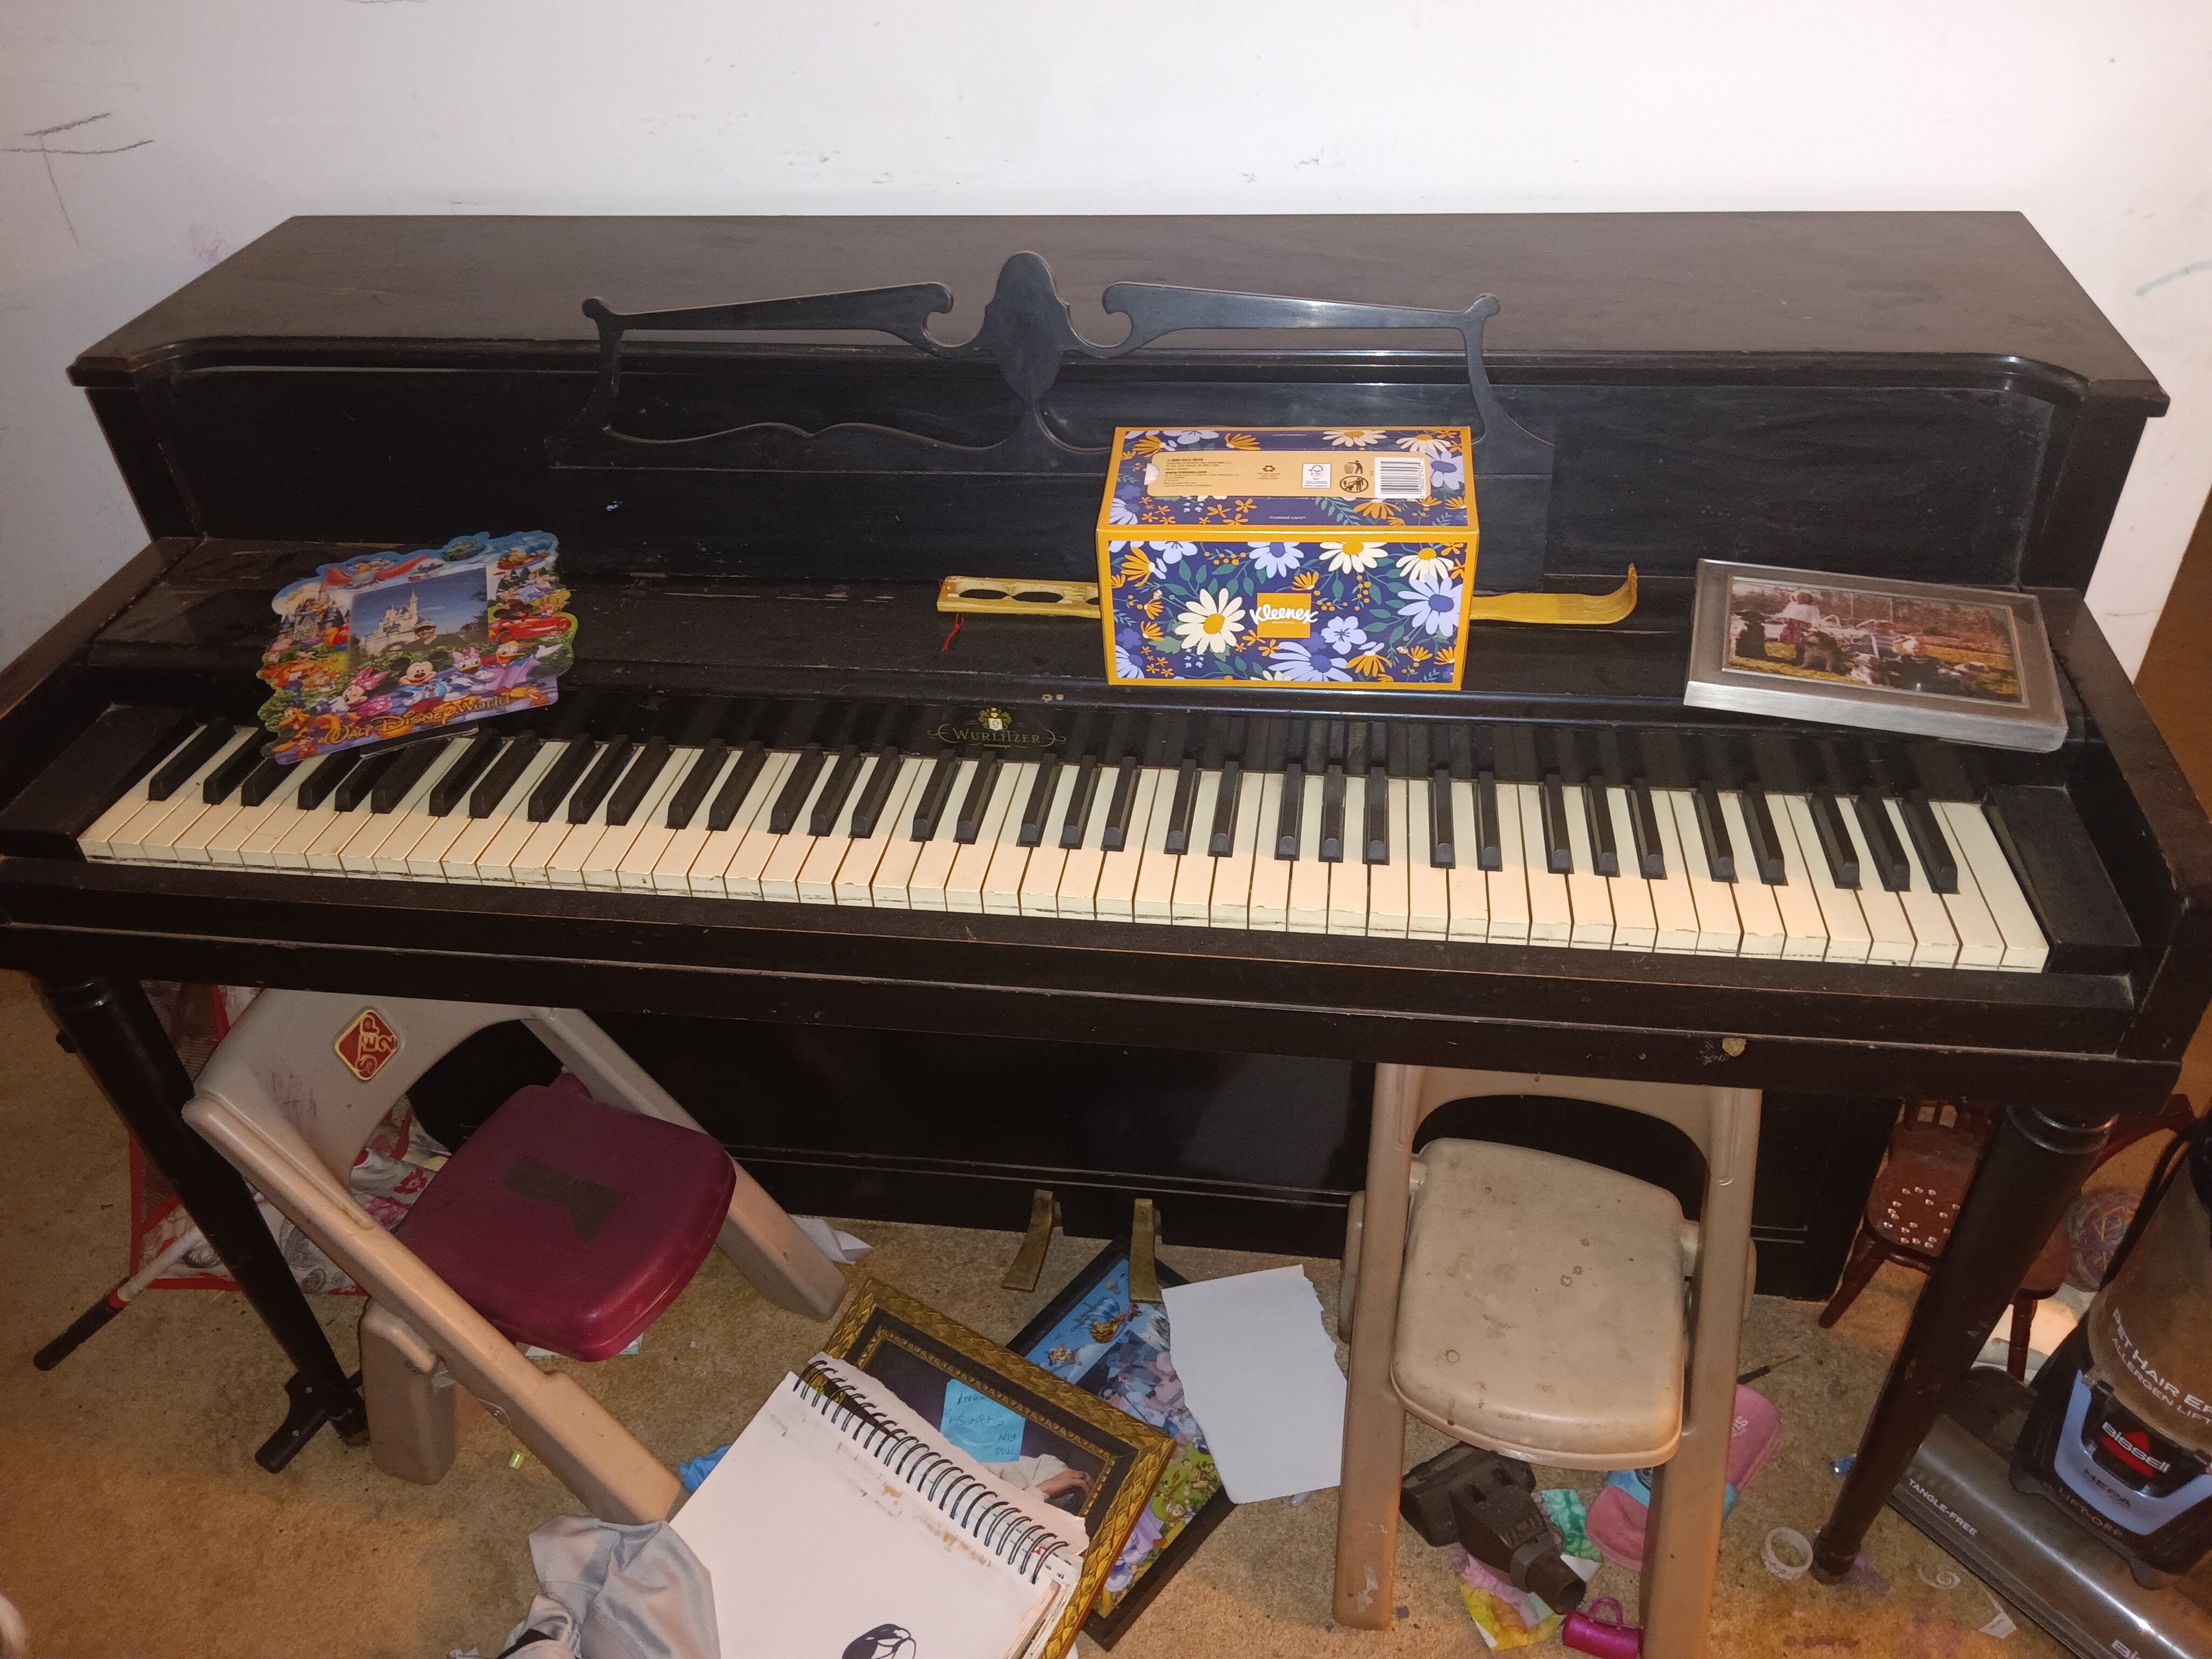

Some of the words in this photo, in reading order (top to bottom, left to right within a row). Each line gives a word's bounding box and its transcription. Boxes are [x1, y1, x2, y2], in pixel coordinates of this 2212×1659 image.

[1249, 603, 1319, 625] Kleenex
[952, 728, 1041, 743] WURLITZER
[355, 1015, 380, 1074] STEP
[378, 1035, 398, 1053] 2
[2112, 1307, 2133, 1347] PET
[2133, 1350, 2180, 1397] HAIR
[2112, 1338, 2175, 1406] ALLERGEN
[1909, 1478, 1978, 1536] TANGLE-FREE
[2083, 1468, 2132, 1507] HEPA
